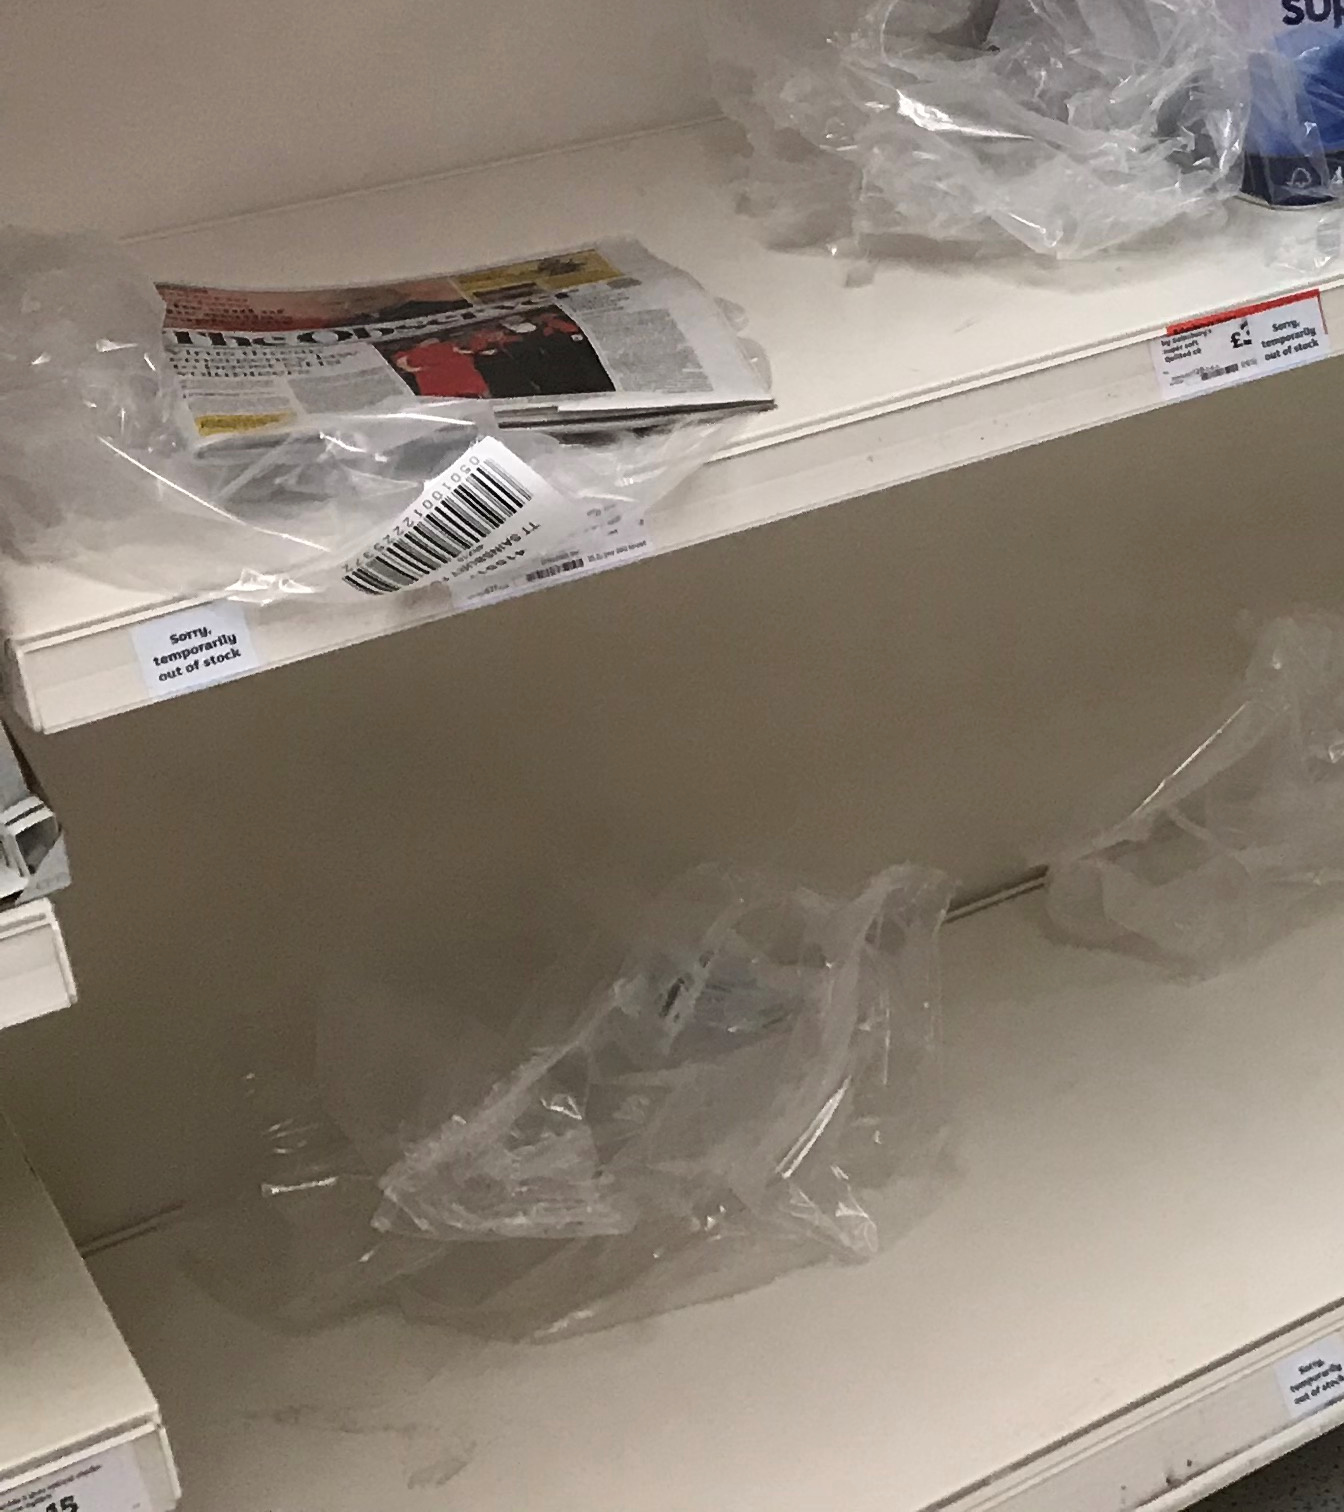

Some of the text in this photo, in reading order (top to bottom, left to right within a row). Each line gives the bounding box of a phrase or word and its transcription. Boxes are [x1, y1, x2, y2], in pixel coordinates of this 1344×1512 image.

[153, 633, 238, 666] temporarily
[169, 626, 213, 645] Sorry,
[158, 648, 241, 682] out of stock
